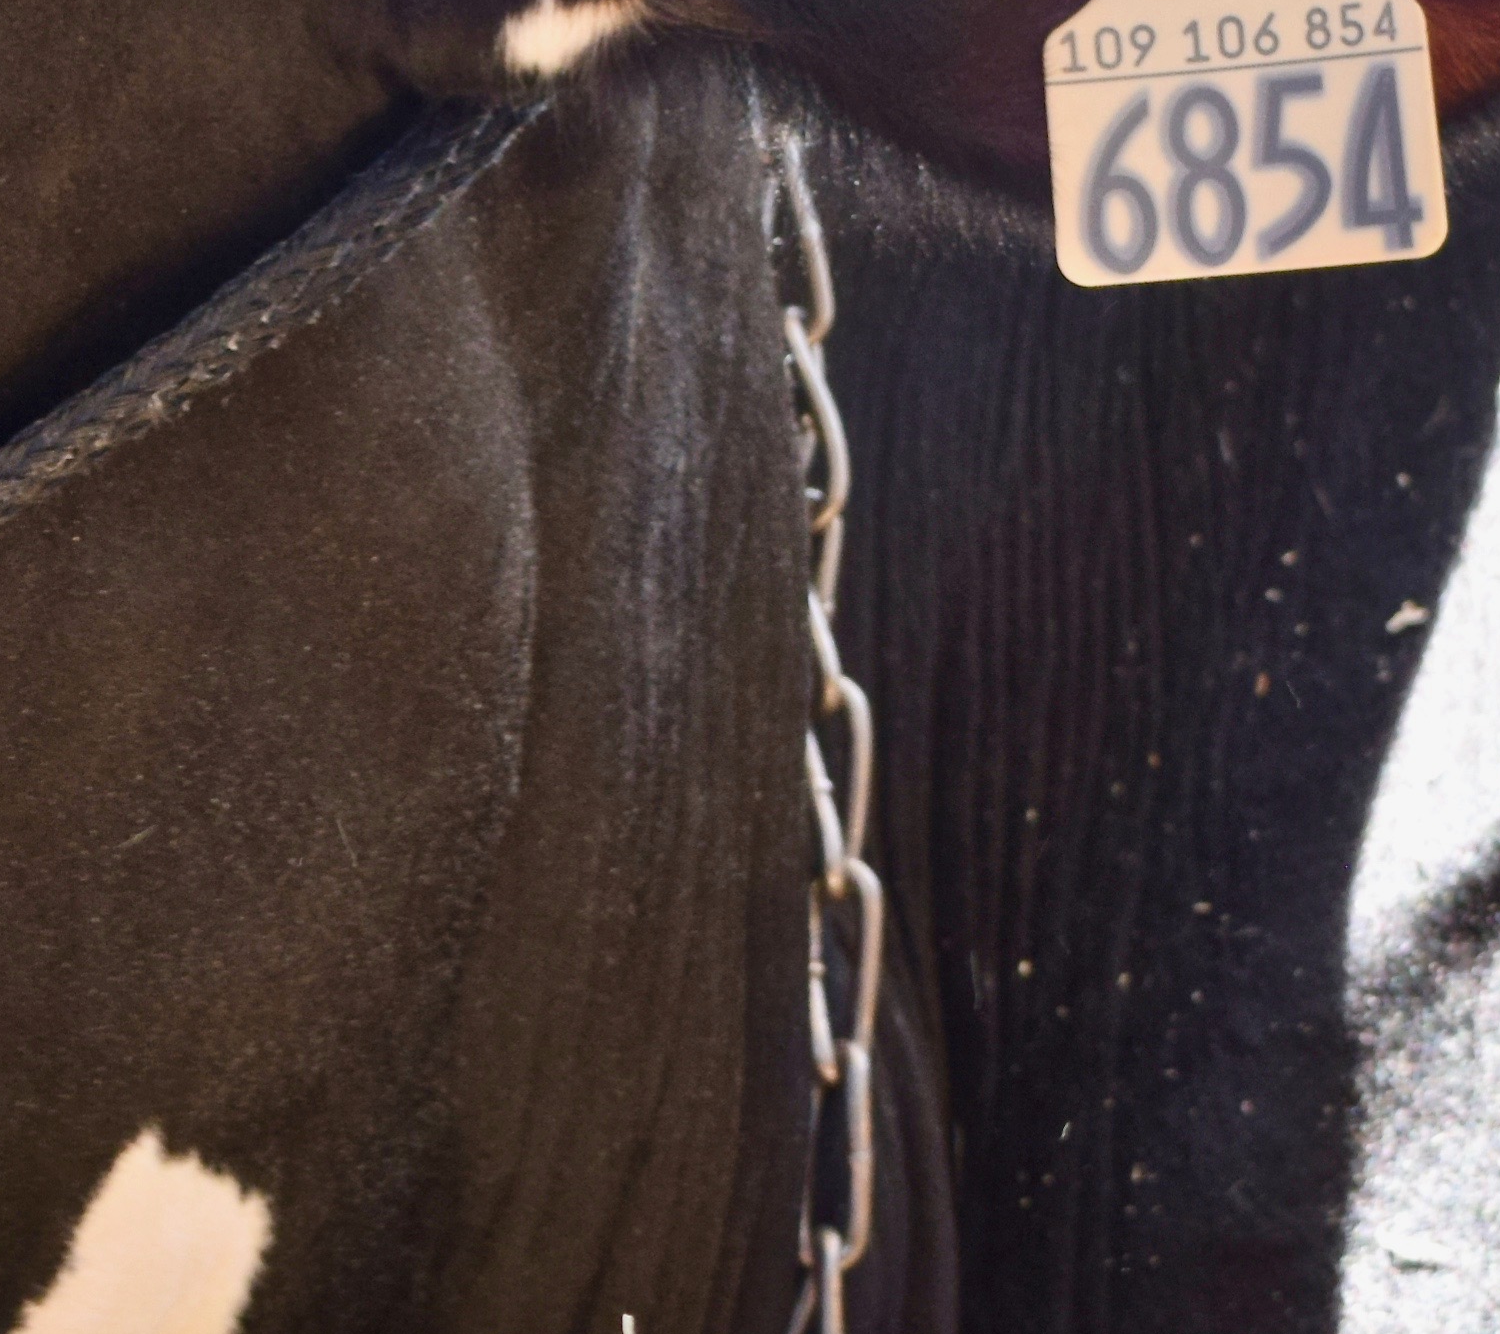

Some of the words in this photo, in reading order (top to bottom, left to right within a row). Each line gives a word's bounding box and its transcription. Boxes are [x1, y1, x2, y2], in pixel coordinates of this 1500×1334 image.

[1060, 23, 1157, 73] 109
[1183, 13, 1281, 63] 106
[1304, 1, 1398, 50] 854
[1080, 63, 1424, 276] 6854
